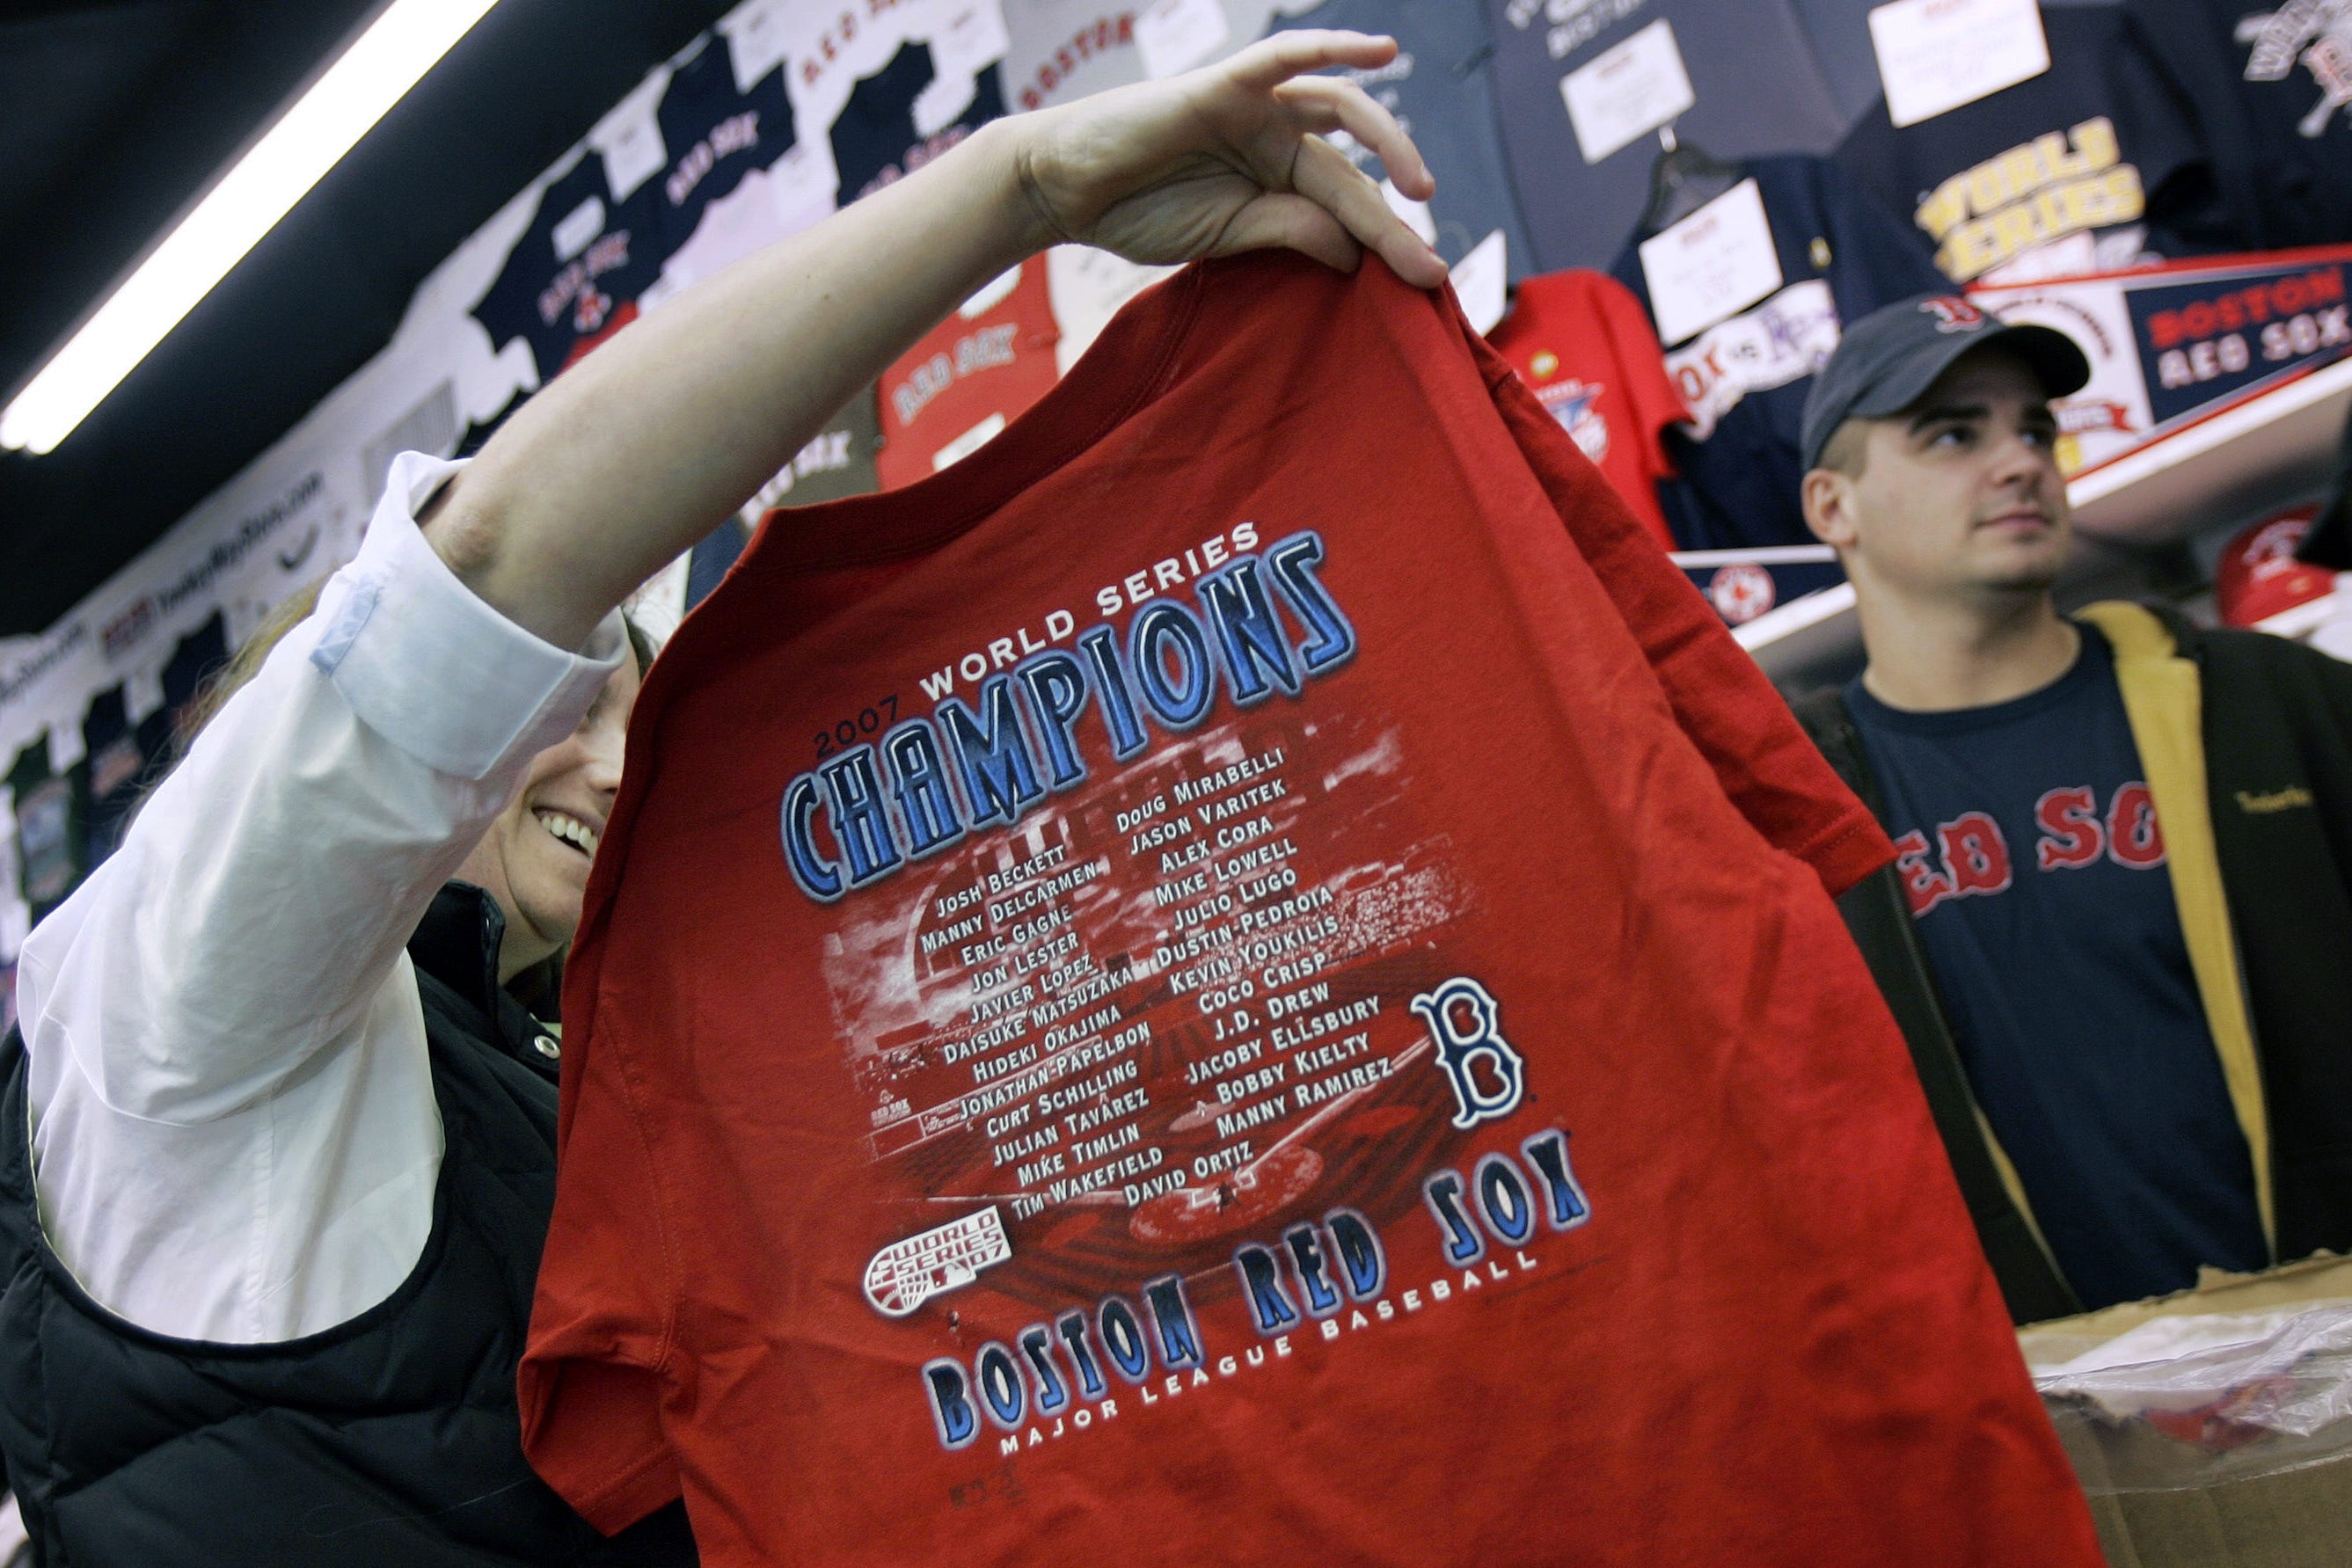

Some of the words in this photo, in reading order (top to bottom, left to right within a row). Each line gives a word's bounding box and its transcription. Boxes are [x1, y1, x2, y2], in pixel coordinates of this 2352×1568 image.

[1019, 11, 1136, 112] BOSTON
[1933, 163, 2146, 286] ERIES
[2147, 266, 2346, 350] BOSTON
[2158, 332, 2250, 390] RED
[2260, 303, 2352, 361] SOX
[891, 352, 954, 427] RED
[953, 322, 1019, 377] SOX
[919, 609, 1075, 702] WORLD
[1096, 521, 1259, 616] SERIES
[780, 529, 1356, 904] CHAMPIONS
[814, 694, 899, 757] 2007
[1116, 795, 1166, 833] DOUG
[1173, 748, 1284, 805] MIRABELLI
[1130, 816, 1192, 855] JASON
[1197, 779, 1287, 825] VARITEK
[937, 885, 982, 918] JOSH
[988, 844, 1065, 894] BECKETT
[1155, 872, 1208, 906] MIKE
[1214, 838, 1297, 882] LOWELL
[1161, 839, 1210, 873] ALEX
[1217, 815, 1274, 850] CORA
[1895, 811, 2012, 919] ED
[2034, 781, 2169, 871] SO
[921, 915, 983, 953] MANNY
[990, 862, 1097, 924] DELCARMEN
[961, 936, 1006, 966] ERIC
[1012, 904, 1073, 944] GAGNE
[1156, 924, 1231, 967] DUSTIN
[1240, 886, 1333, 934] PEDROIA
[1174, 893, 1231, 930] JULIO
[1239, 868, 1297, 904] LUGO
[970, 984, 1034, 1024] JAVIER
[1040, 953, 1093, 994] LOPEZ
[972, 965, 1008, 994] JON
[1015, 931, 1079, 974] LESTER
[1170, 957, 1231, 995] KEVIN
[1239, 915, 1339, 965] YOUKILIS
[1199, 979, 1254, 1014] COCO
[1263, 952, 1326, 988] CRISP
[943, 1019, 1027, 1065] DAISUKE
[1032, 966, 1133, 1028] MATSUZAKA
[973, 1043, 1038, 1083] HIDEKI
[1044, 1004, 1121, 1051] OKAJIMA
[1188, 1038, 1262, 1084] JACOBY
[1271, 995, 1380, 1051] ELLSBURY
[1215, 1010, 1260, 1041] J.D.
[1267, 981, 1330, 1019] DREW
[960, 1067, 1049, 1120] JONATHAN
[1055, 1021, 1151, 1077] PAPELBON
[1216, 1061, 1285, 1105] BOBBY
[1295, 1032, 1369, 1075] KIELTY
[1410, 976, 1523, 1130] B
[986, 1105, 1030, 1139] CURT
[1038, 1059, 1137, 1115] SCHILLING
[1216, 1095, 1286, 1139] MANNY
[1295, 1056, 1393, 1107] RAMIREZ
[993, 1125, 1059, 1167] JULIAN
[1012, 1192, 1045, 1221] TIM
[1049, 1146, 1163, 1203] WAKEFIELD
[1017, 1152, 1064, 1187] MIKE
[1070, 1123, 1140, 1164] TIMLIN
[1124, 1169, 1186, 1207] DAVID
[1194, 1141, 1254, 1178] ORTIZ
[892, 1211, 997, 1262] WORLD
[896, 1227, 1003, 1276] SERIES
[970, 1242, 1006, 1268] 07
[921, 1272, 1206, 1450] BOSTON
[1235, 1203, 1388, 1337] RED
[1422, 1127, 1591, 1267] SOX
[1000, 1399, 1119, 1455] MAJOR
[1141, 1335, 1292, 1405] LEAGUE
[1320, 1251, 1538, 1340] BASEBALL
